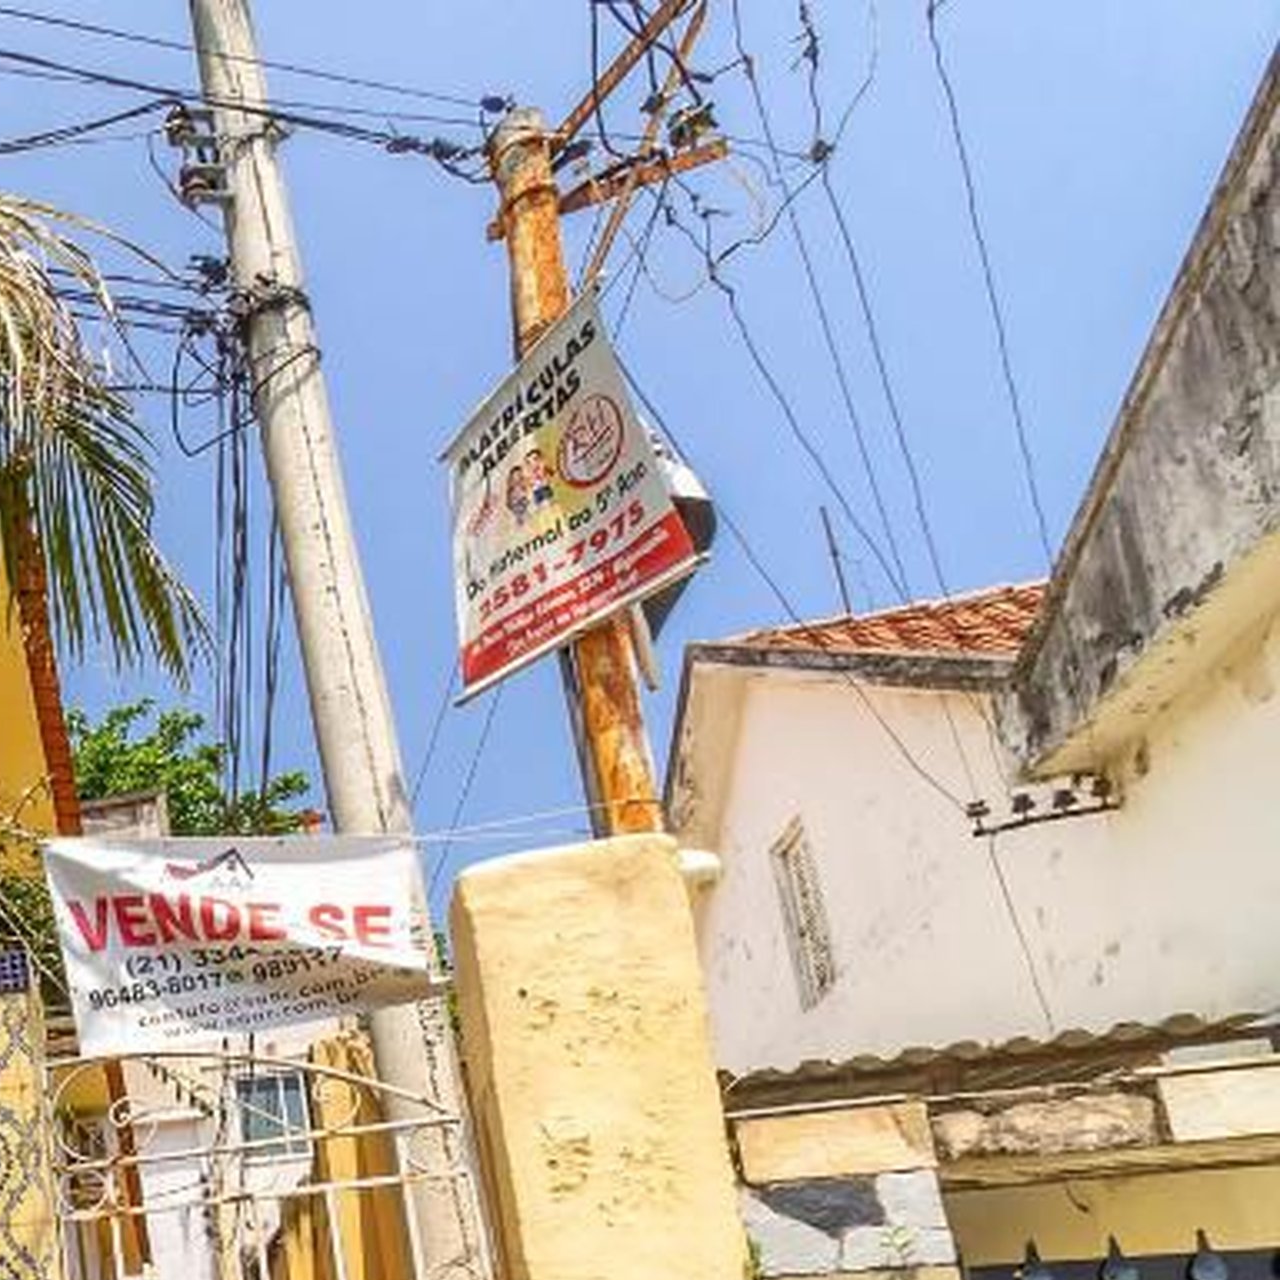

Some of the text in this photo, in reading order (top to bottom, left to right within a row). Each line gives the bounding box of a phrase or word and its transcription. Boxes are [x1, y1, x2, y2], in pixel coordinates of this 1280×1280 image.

[480, 369, 581, 477] ABERTAS
[569, 508, 592, 531] ao
[66, 892, 395, 952] VENDE SE
[126, 951, 183, 980] (21)
